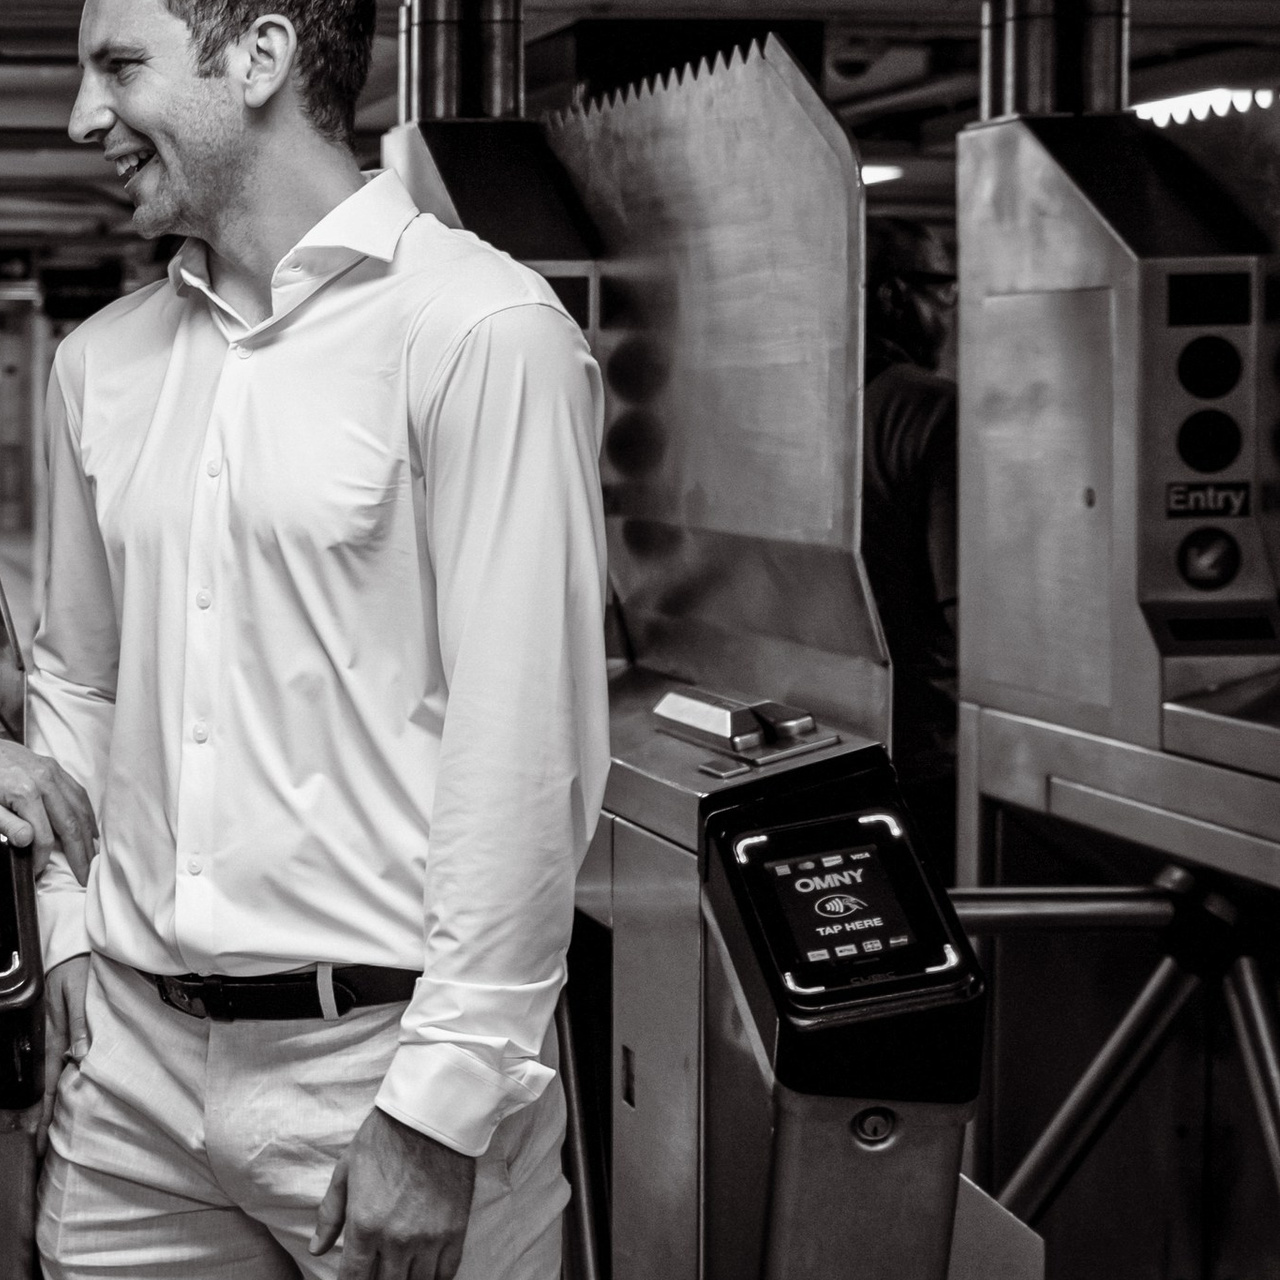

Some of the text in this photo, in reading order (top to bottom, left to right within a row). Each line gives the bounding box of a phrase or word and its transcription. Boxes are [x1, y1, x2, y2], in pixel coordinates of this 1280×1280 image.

[1169, 485, 1246, 516] Entry
[794, 868, 864, 893] OMNY
[815, 917, 884, 936] TAP HERE
